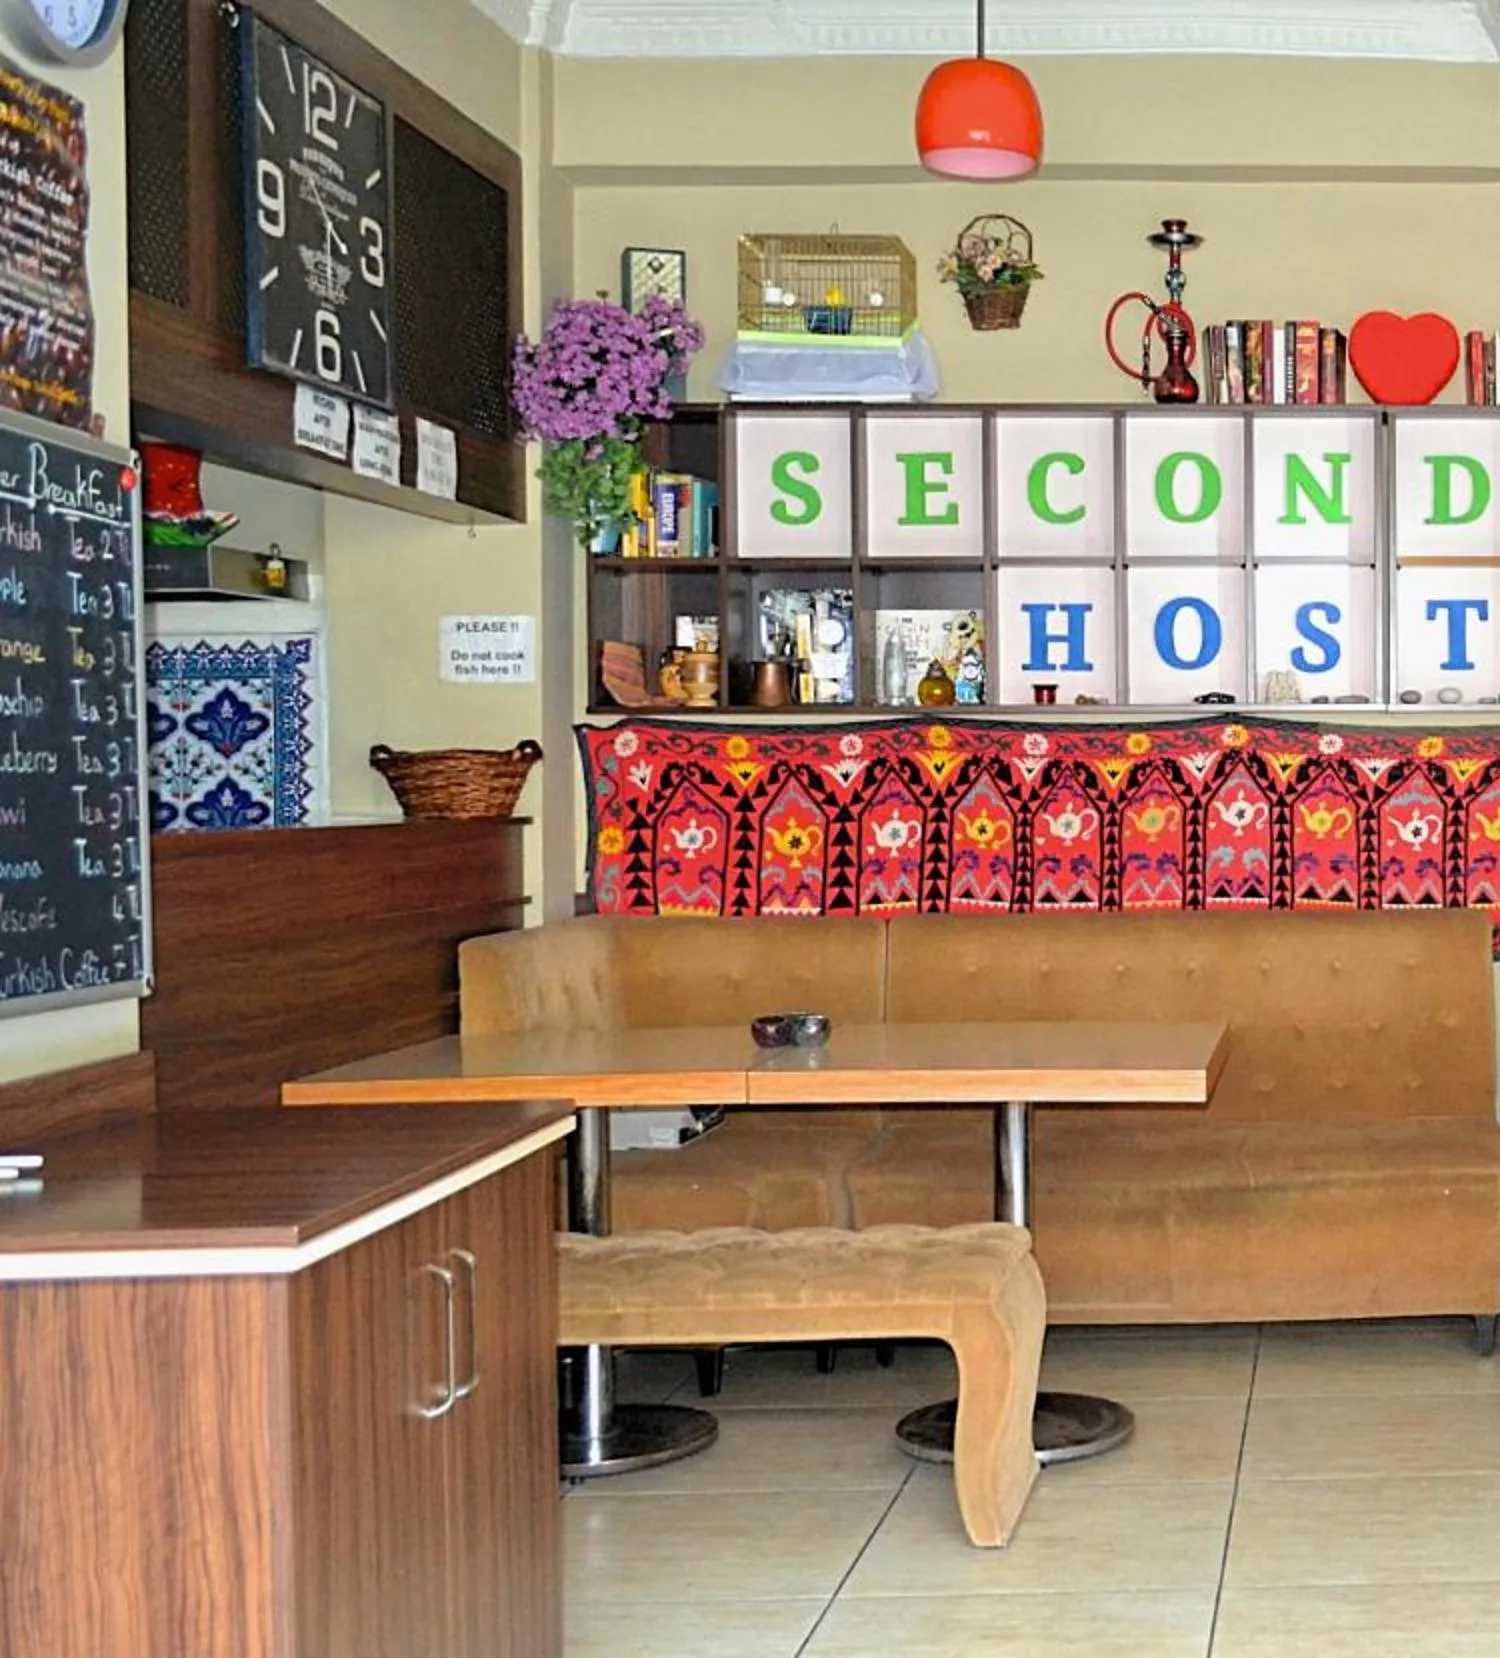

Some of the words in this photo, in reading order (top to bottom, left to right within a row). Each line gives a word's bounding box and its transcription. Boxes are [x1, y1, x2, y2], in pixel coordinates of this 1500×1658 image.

[302, 62, 338, 151] 12
[257, 157, 285, 238] 9
[359, 216, 386, 289] 3
[314, 310, 342, 383] 6
[661, 491, 676, 535] EUROPE
[65, 515, 95, 561] Tea
[100, 530, 114, 559] 2
[0, 567, 27, 606] ple
[66, 570, 98, 616] Tea
[101, 583, 115, 619] 3
[456, 621, 508, 633] PLEASE
[66, 626, 96, 670] Tea
[101, 637, 117, 676] 3
[451, 649, 470, 661] Do
[471, 651, 492, 661] not
[495, 651, 524, 661] cook
[454, 664, 480, 675] fish
[481, 664, 509, 675] here
[70, 678, 101, 722] Tea
[104, 694, 119, 725] 3
[0, 729, 58, 774] eberry
[71, 735, 104, 774] Tea
[106, 741, 121, 778] 3
[71, 785, 105, 826] Tea
[108, 792, 122, 830] 3
[73, 837, 106, 878] Tea
[111, 842, 124, 878] 3
[60, 947, 111, 991] Coffee
